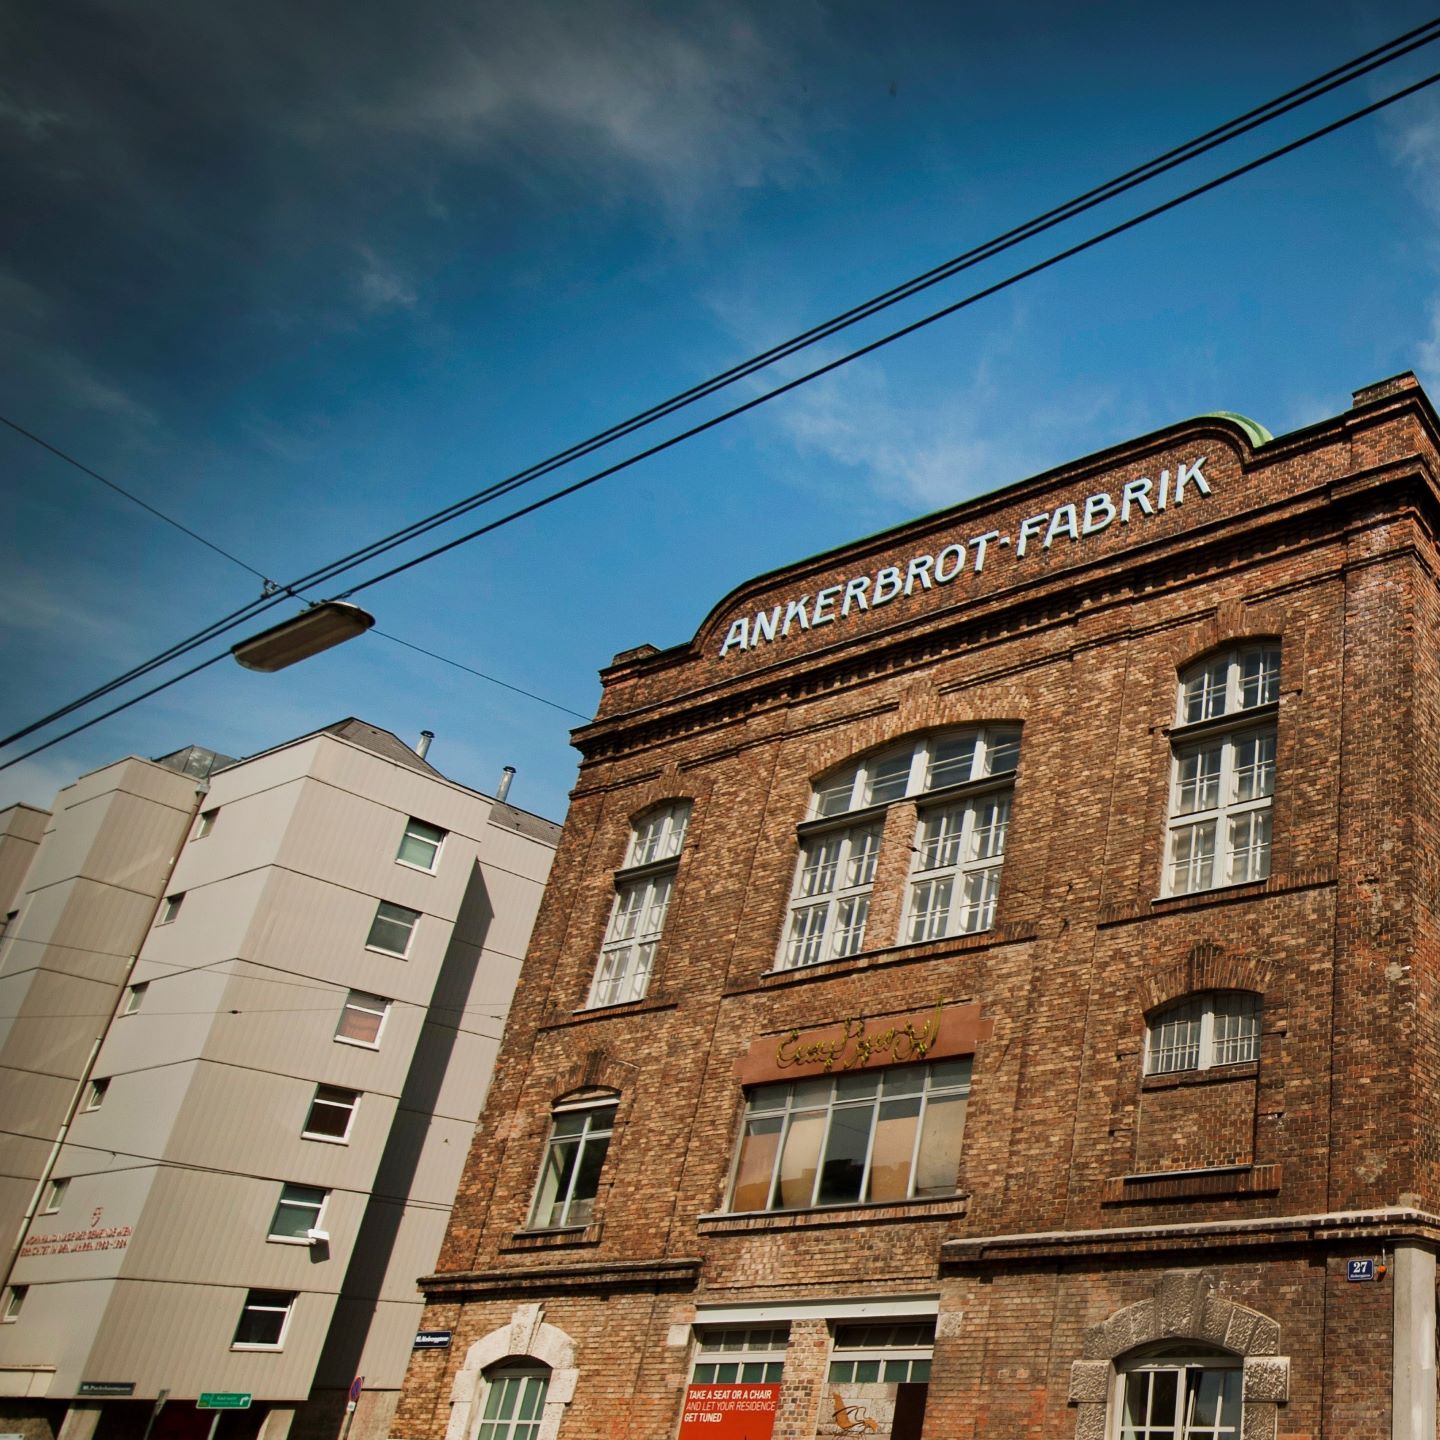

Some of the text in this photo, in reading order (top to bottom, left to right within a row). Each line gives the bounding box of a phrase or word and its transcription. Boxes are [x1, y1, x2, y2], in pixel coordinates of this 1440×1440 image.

[1353, 1261, 1368, 1273] 27
[689, 1390, 772, 1400] TAKE A SEAT OR A CHAIR
[686, 1401, 776, 1411] AND LET YOUR RESIDENCE
[684, 1413, 722, 1423] GET TUNED
